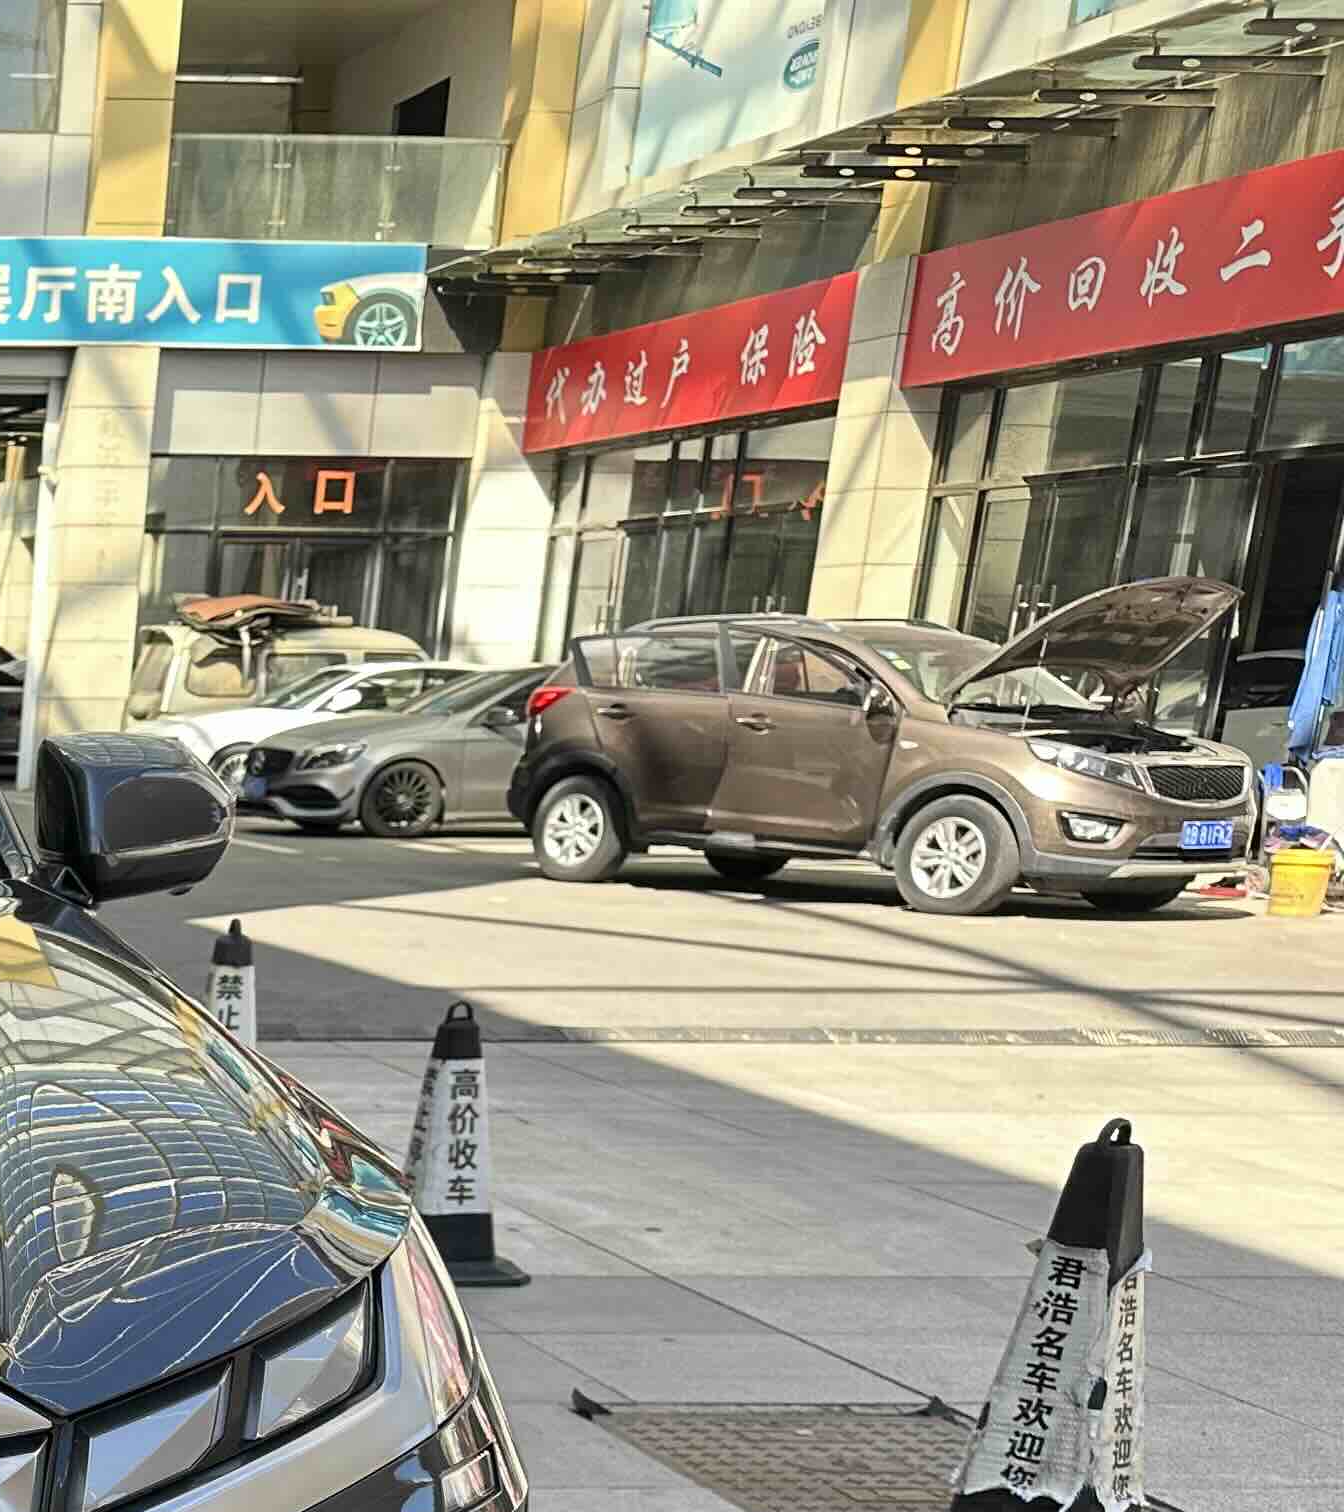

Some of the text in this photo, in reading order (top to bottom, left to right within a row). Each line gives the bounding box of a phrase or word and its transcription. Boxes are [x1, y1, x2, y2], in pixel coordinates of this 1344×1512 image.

[544, 307, 827, 424] 代办过户 保险
[243, 469, 358, 517] 入口
[444, 1068, 481, 1207] 高价收车
